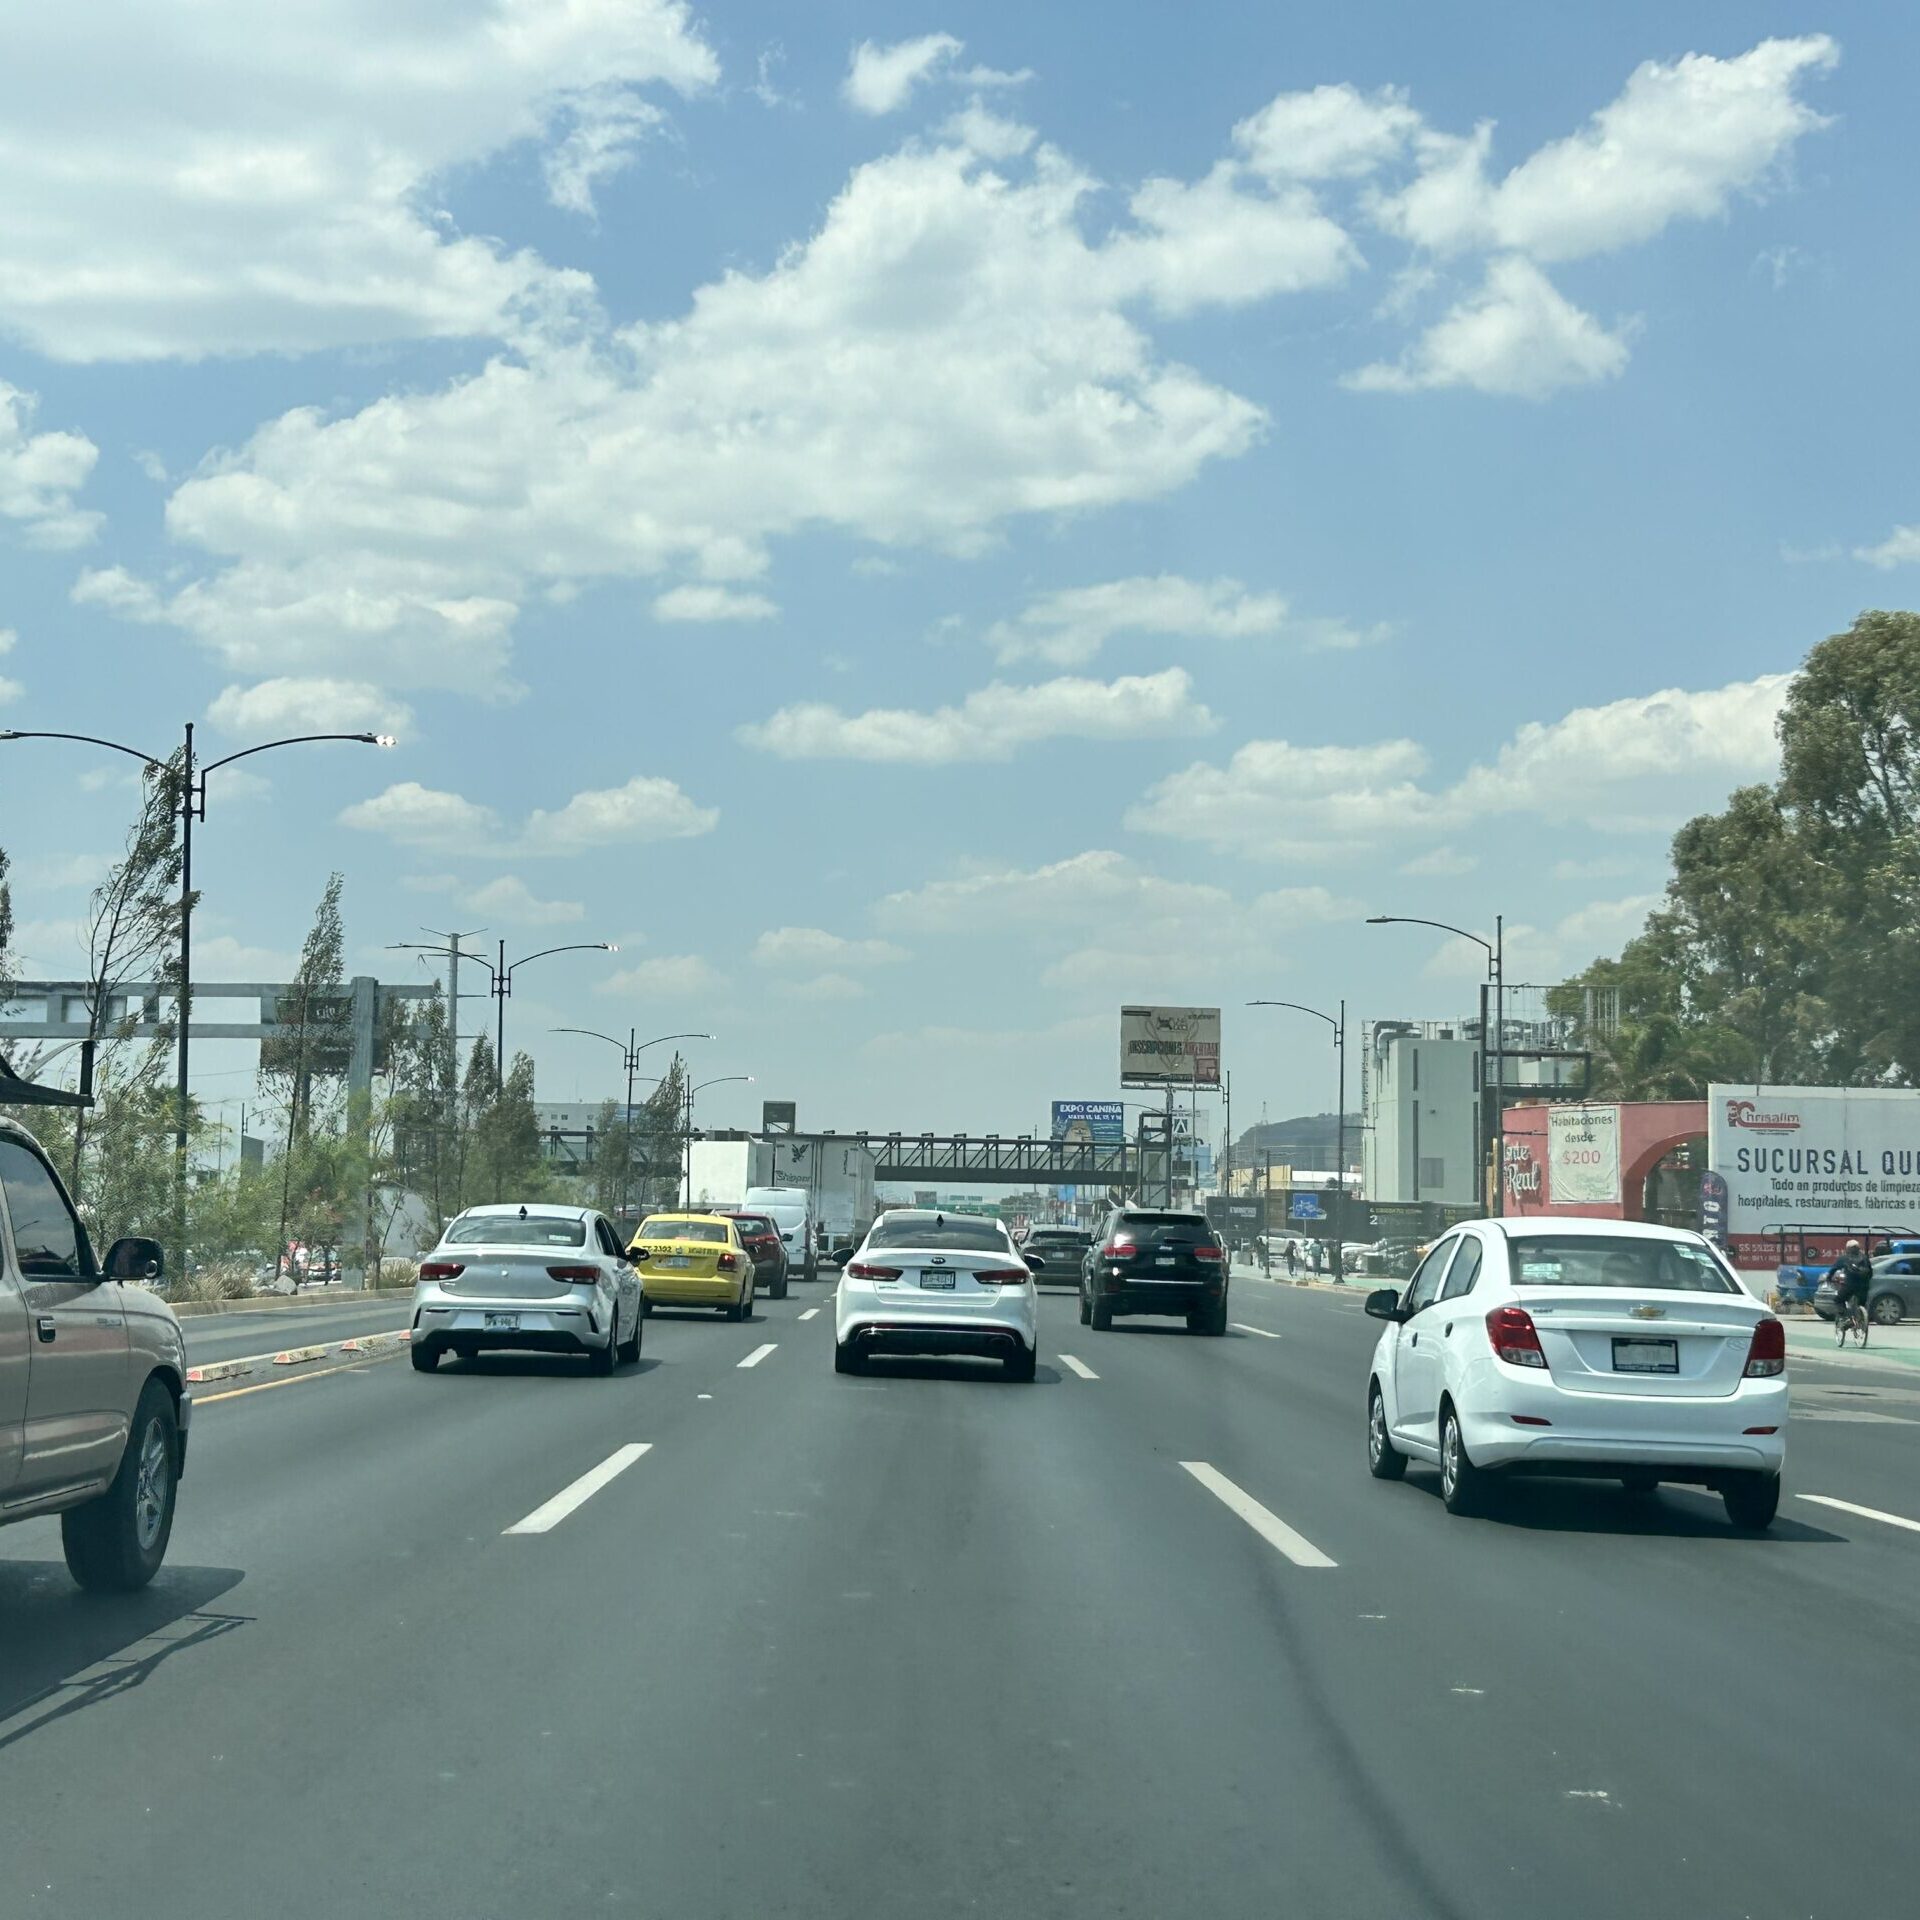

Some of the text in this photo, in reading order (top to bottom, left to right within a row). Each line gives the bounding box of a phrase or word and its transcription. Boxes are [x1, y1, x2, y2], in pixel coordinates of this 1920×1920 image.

[1086, 1105, 1121, 1113] CANINA
[1564, 1131, 1595, 1143] desde
[1563, 1150, 1601, 1164] $200
[1738, 1148, 1868, 1175] SUCURSAL
[1508, 1161, 1541, 1200] Real
[1771, 1178, 1794, 1191] Todo
[1812, 1180, 1862, 1194] productos
[1866, 1179, 1878, 1192] de
